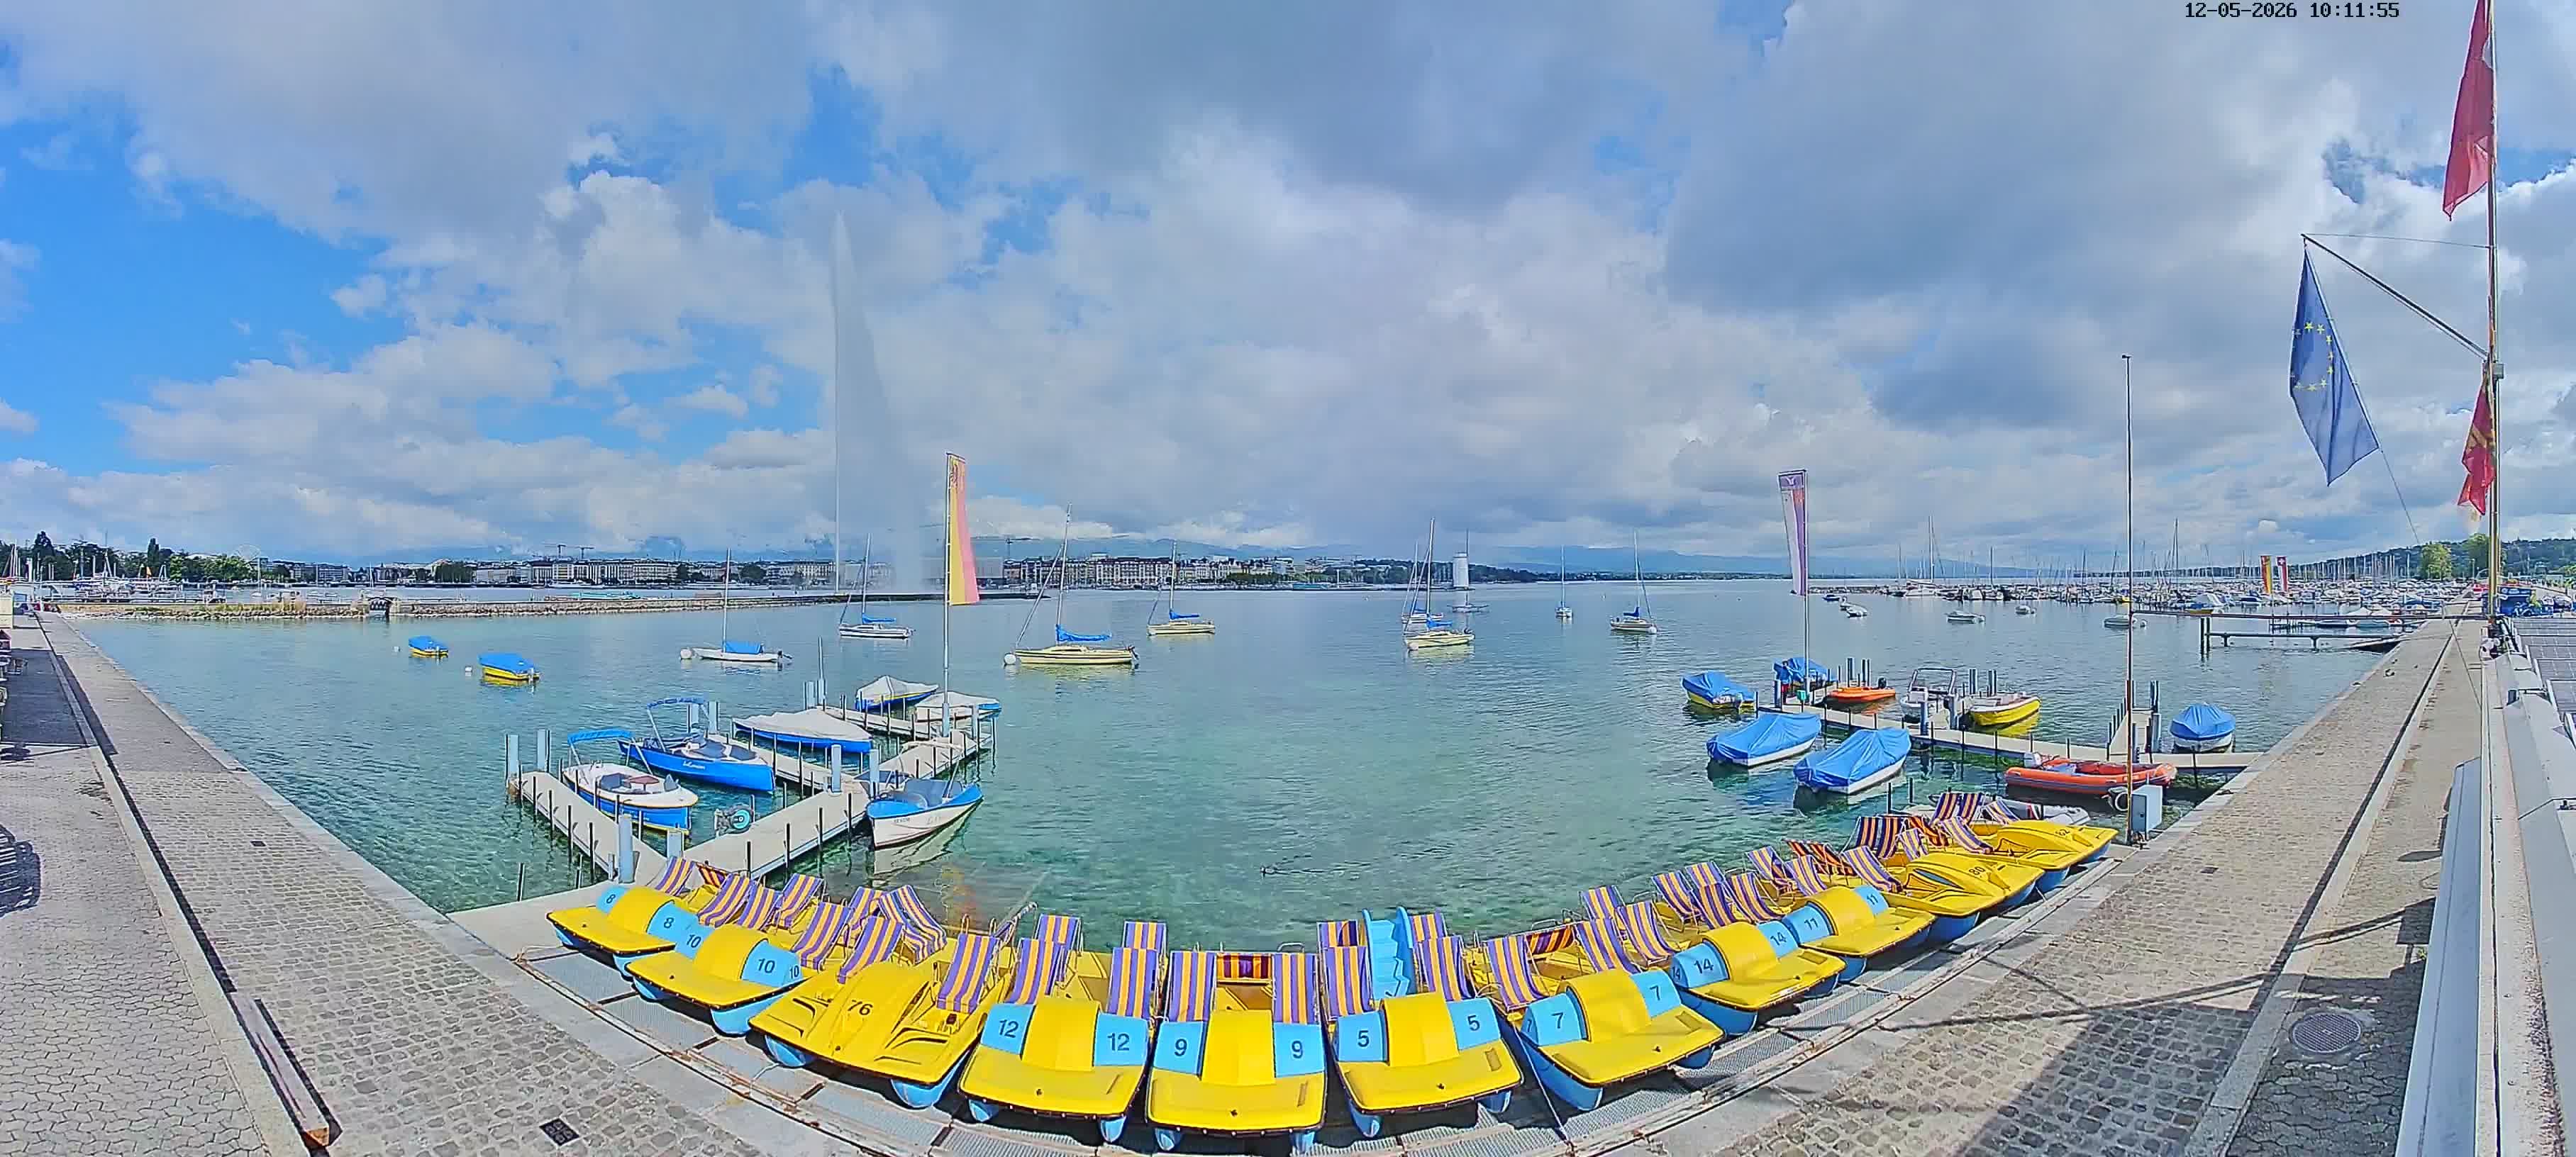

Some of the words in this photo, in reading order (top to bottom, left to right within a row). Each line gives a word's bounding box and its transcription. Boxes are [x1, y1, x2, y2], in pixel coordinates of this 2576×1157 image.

[1968, 866, 1985, 876] 80
[606, 894, 616, 904] 8
[1867, 893, 1879, 905] 11
[663, 917, 674, 929] 8
[1804, 917, 1819, 930] 11
[686, 934, 701, 949] 10
[1770, 932, 1787, 946] 14
[757, 958, 775, 973] 10
[789, 965, 800, 979] 10
[1672, 966, 1681, 980] 14
[1694, 958, 1714, 974] 14
[1649, 985, 1661, 1001] 7
[847, 999, 874, 1016] 76
[1467, 1015, 1481, 1032] 5
[1526, 1019, 1533, 1033] 7
[1551, 1012, 1564, 1029] 7
[999, 1019, 1019, 1039] 12
[1107, 1032, 1130, 1051] 12
[1358, 1029, 1370, 1048] 5
[1174, 1038, 1188, 1057] 9
[1291, 1040, 1304, 1059] 9
